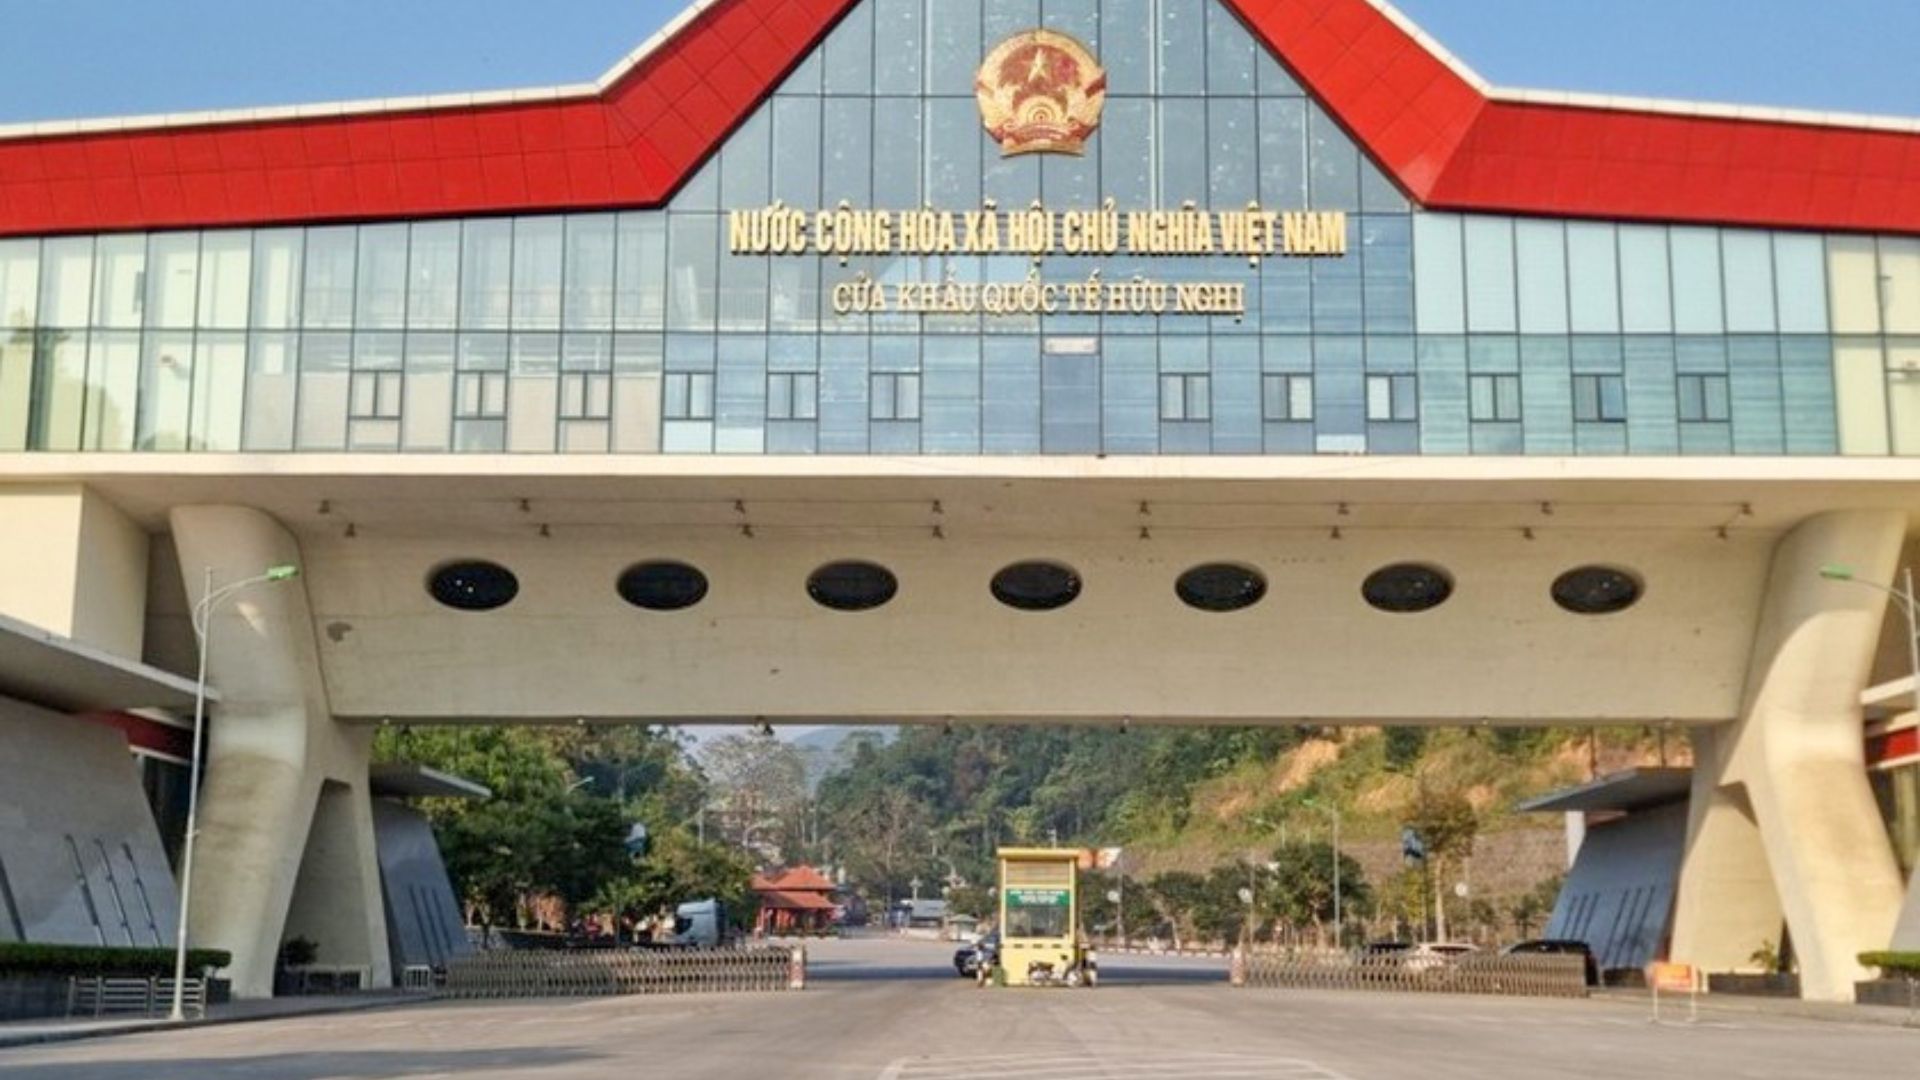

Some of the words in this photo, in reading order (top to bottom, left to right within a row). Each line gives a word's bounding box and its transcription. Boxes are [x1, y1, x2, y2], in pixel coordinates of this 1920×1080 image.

[729, 198, 806, 252] NƯỚC
[815, 198, 891, 263] CỘNG
[899, 200, 956, 252] HÒA
[964, 198, 998, 252] XÃ
[1008, 199, 1055, 263] HỘI
[1062, 196, 1118, 252] CHỦ
[1128, 199, 1213, 252] NGHĨA
[1219, 200, 1277, 264] VIỆT
[1283, 210, 1345, 253] NAM
[833, 268, 886, 312] CỬA
[896, 262, 977, 312] KHẨU
[982, 267, 1059, 313] QUỐC
[1065, 268, 1101, 312] TẾ
[1106, 275, 1167, 312] HỮU
[1175, 282, 1244, 322] NGHỊ
